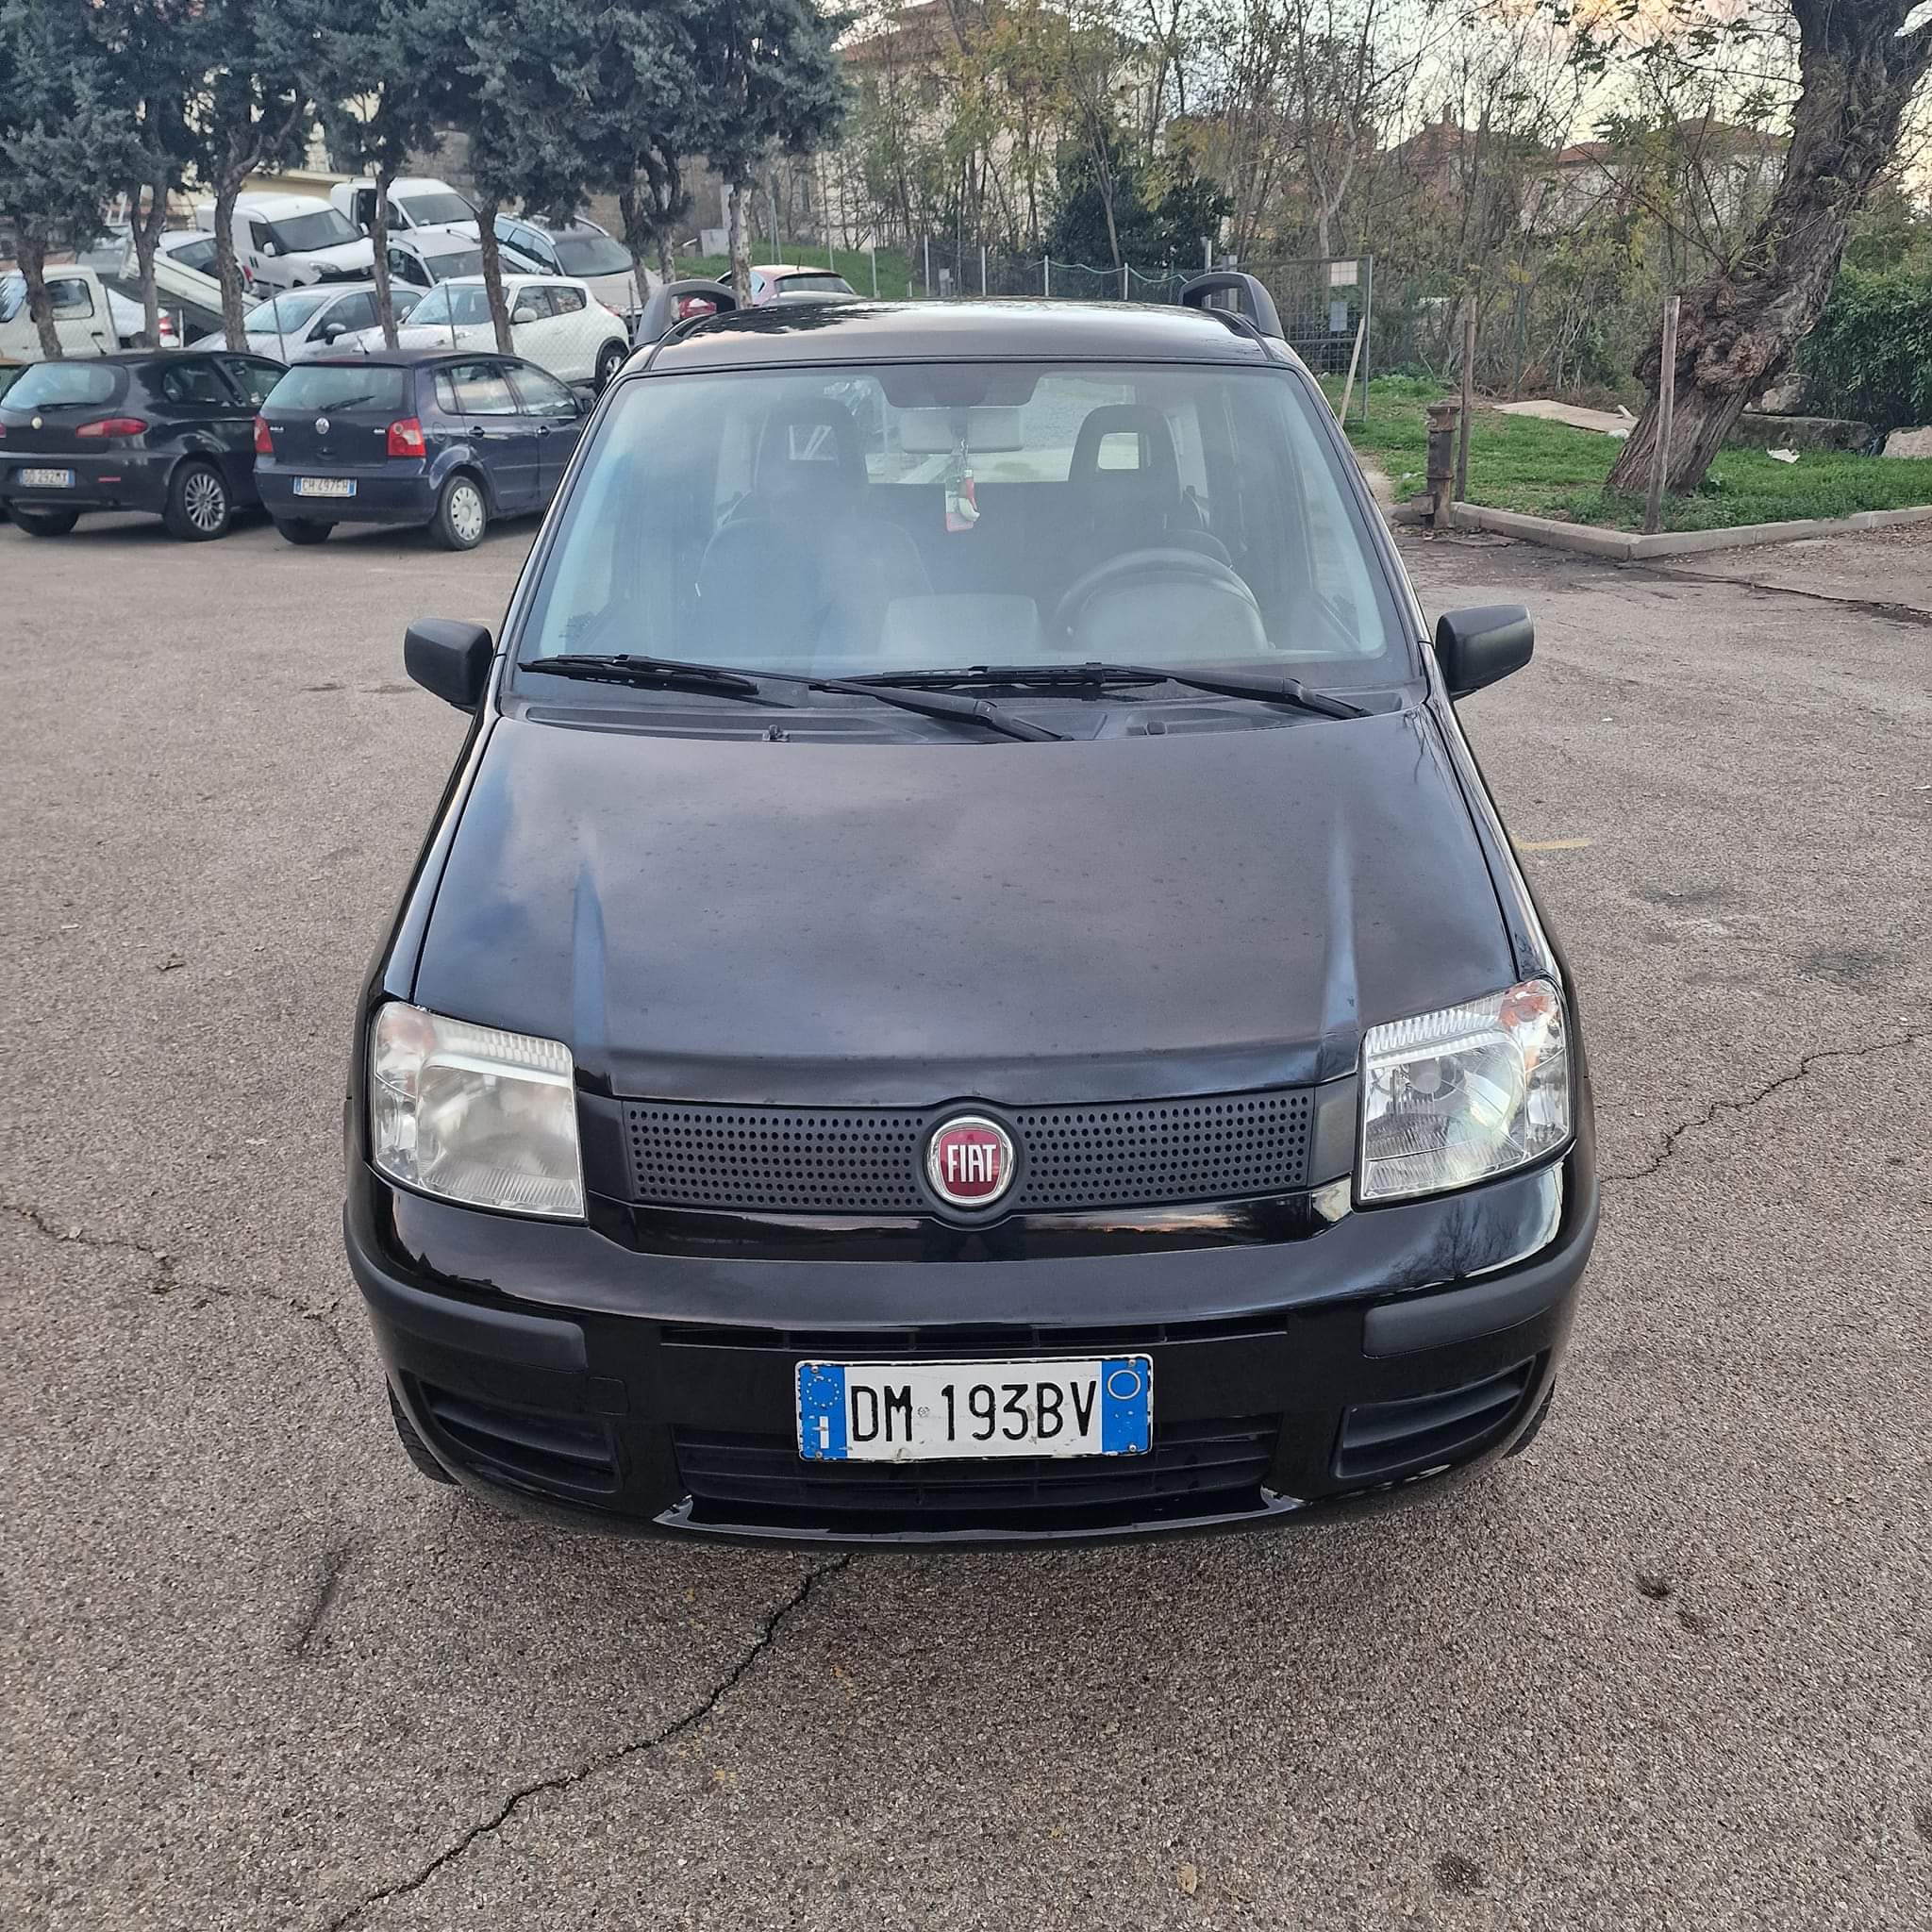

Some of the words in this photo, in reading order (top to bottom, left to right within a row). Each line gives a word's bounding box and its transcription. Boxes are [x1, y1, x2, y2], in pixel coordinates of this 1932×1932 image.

[947, 1144, 997, 1183] FIAT
[850, 1384, 912, 1442] DM
[941, 1380, 1097, 1441] 193BV
